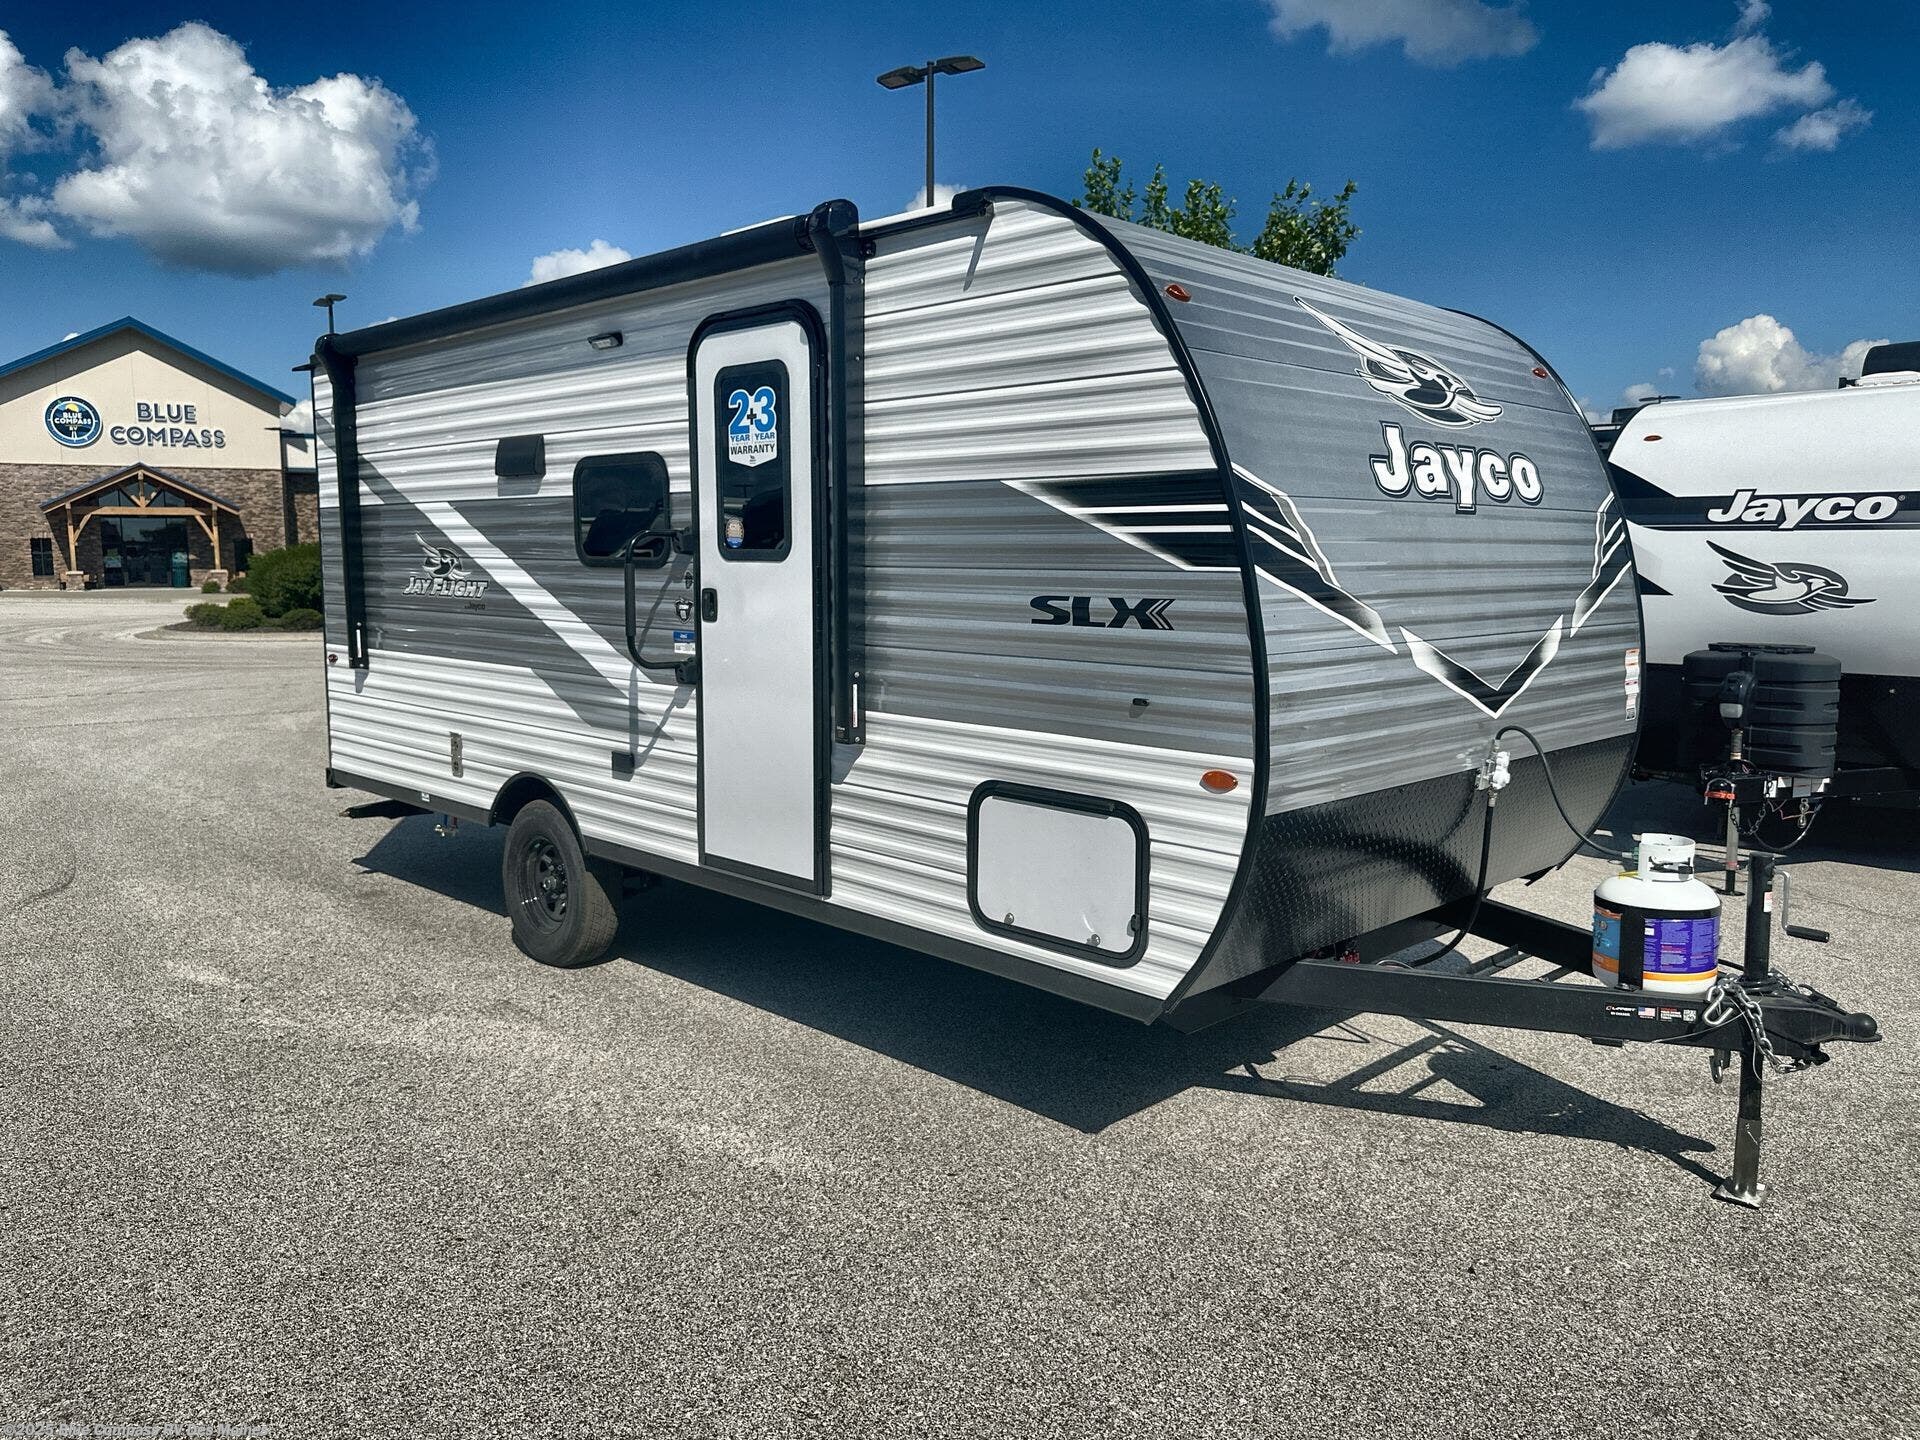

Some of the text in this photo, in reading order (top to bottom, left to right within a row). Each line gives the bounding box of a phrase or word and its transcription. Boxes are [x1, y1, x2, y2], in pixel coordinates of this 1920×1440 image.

[54, 417, 92, 425] COMPASS
[136, 402, 198, 424] BLUE
[110, 425, 226, 448] COMPASS
[730, 432, 775, 442] YEAR YEAR
[730, 443, 775, 455] WARRANTY
[1369, 420, 1544, 514] Jayco
[402, 576, 488, 599] JAY FLIGHT
[1030, 595, 1176, 631] SLX
